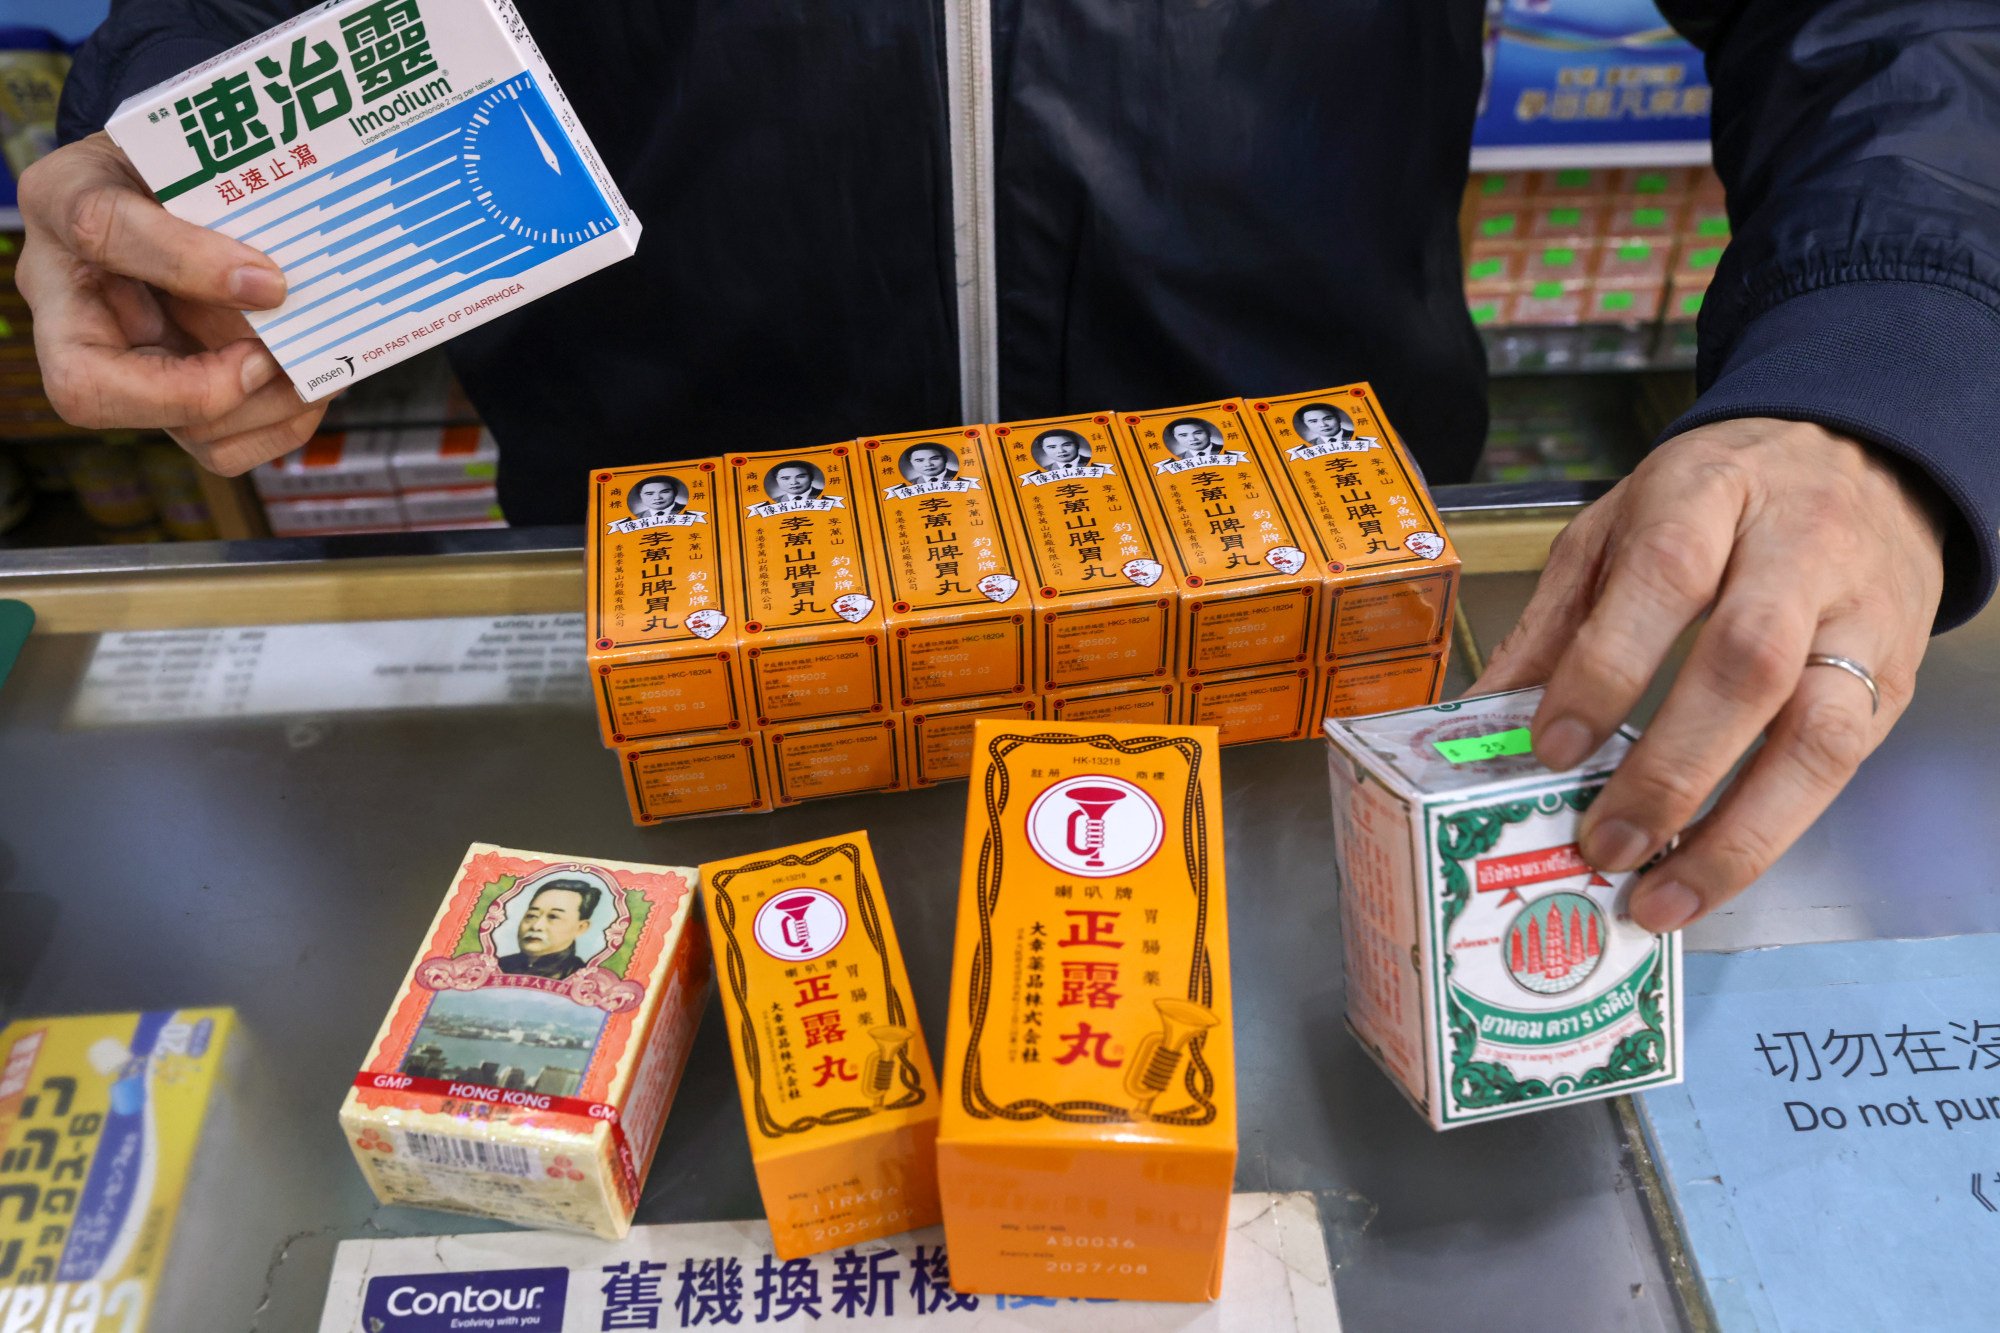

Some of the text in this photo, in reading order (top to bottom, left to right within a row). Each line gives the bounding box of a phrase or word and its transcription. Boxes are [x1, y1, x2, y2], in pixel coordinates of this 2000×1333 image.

[153, 0, 438, 201] 速治靈
[361, 121, 401, 146] Loperamide
[400, 101, 446, 128] hydrochloride
[452, 92, 467, 105] mg
[466, 86, 479, 101] per
[478, 77, 496, 94] tablet
[215, 142, 319, 206] 迅速止瀉
[362, 282, 525, 363] FOR FAST RELIEF OF DIARRHOEA
[1055, 483, 1117, 581] 李萬山脾胃丸
[1191, 471, 1261, 569] 李萬山脾胃丸
[1325, 457, 1400, 554] 李萬山脾胃丸
[779, 516, 826, 616] 李萬山脾胃丸
[917, 497, 971, 596] 李萬山脾胃丸
[639, 531, 679, 632] 李萬山脾胃丸
[1252, 603, 1294, 616] HKC-18204
[962, 630, 1005, 643] HKC-18204
[1107, 615, 1151, 628] HKC-18204
[667, 668, 713, 680] HKC-18204
[815, 652, 860, 663] HKC-18204
[1071, 755, 1121, 766] HK-13218
[1052, 909, 1125, 1068] 正露丸
[1481, 982, 1635, 1040] ยาหอม ตรา 5 เจดีย์
[793, 973, 859, 1088] 正露丸
[373, 1074, 413, 1089] GMP
[448, 1082, 551, 1110] HONG KONG
[1783, 1095, 2000, 1131] Do not pur
[450, 1315, 540, 1329] Evolving with you
